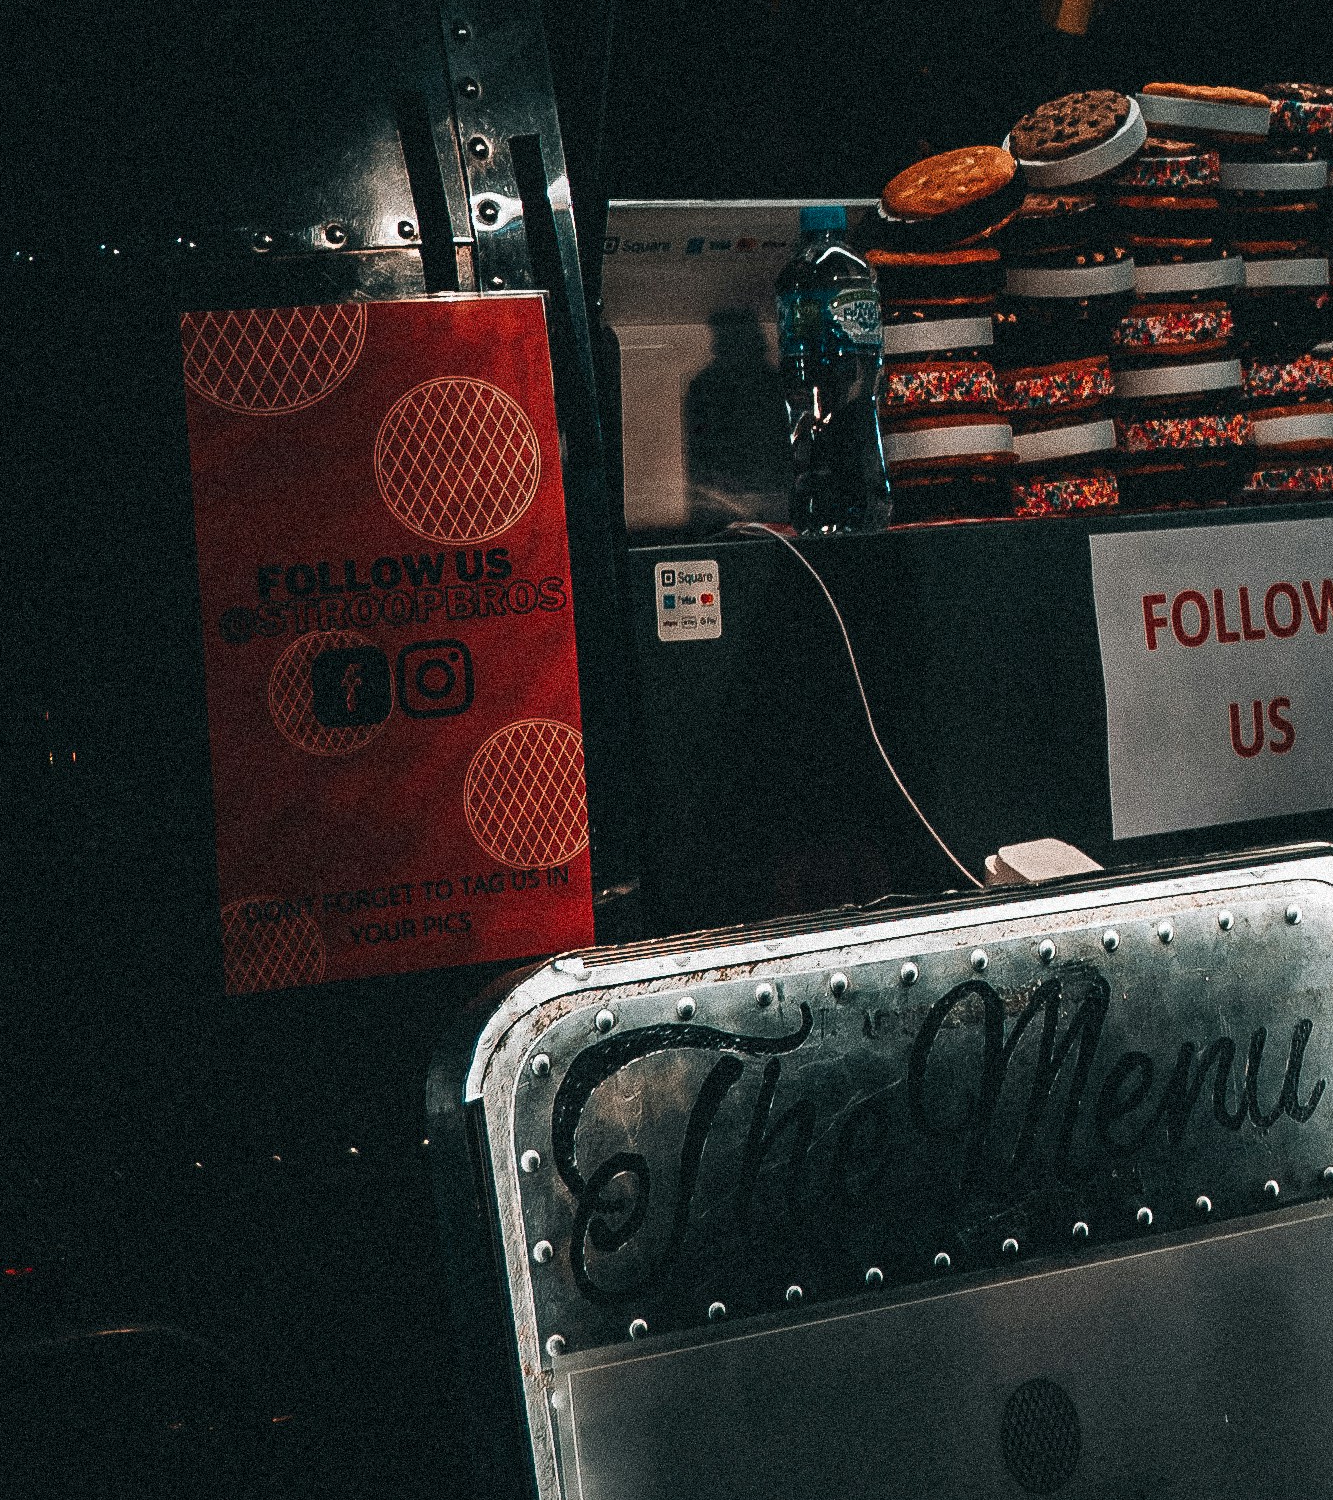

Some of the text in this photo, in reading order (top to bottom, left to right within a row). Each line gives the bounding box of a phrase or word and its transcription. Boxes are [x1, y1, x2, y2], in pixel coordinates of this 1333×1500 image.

[257, 547, 513, 598] FOLLOW US
[677, 571, 714, 586] Square
[219, 576, 567, 645] @STROOPBROS
[1228, 697, 1295, 759] US
[322, 883, 414, 914] FORGET
[421, 879, 454, 902] TO
[460, 873, 505, 897] TAG
[510, 868, 541, 891] US
[546, 865, 569, 887] IN
[348, 912, 473, 945] YOUR PICS
[551, 958, 1327, 1304] The Menu
